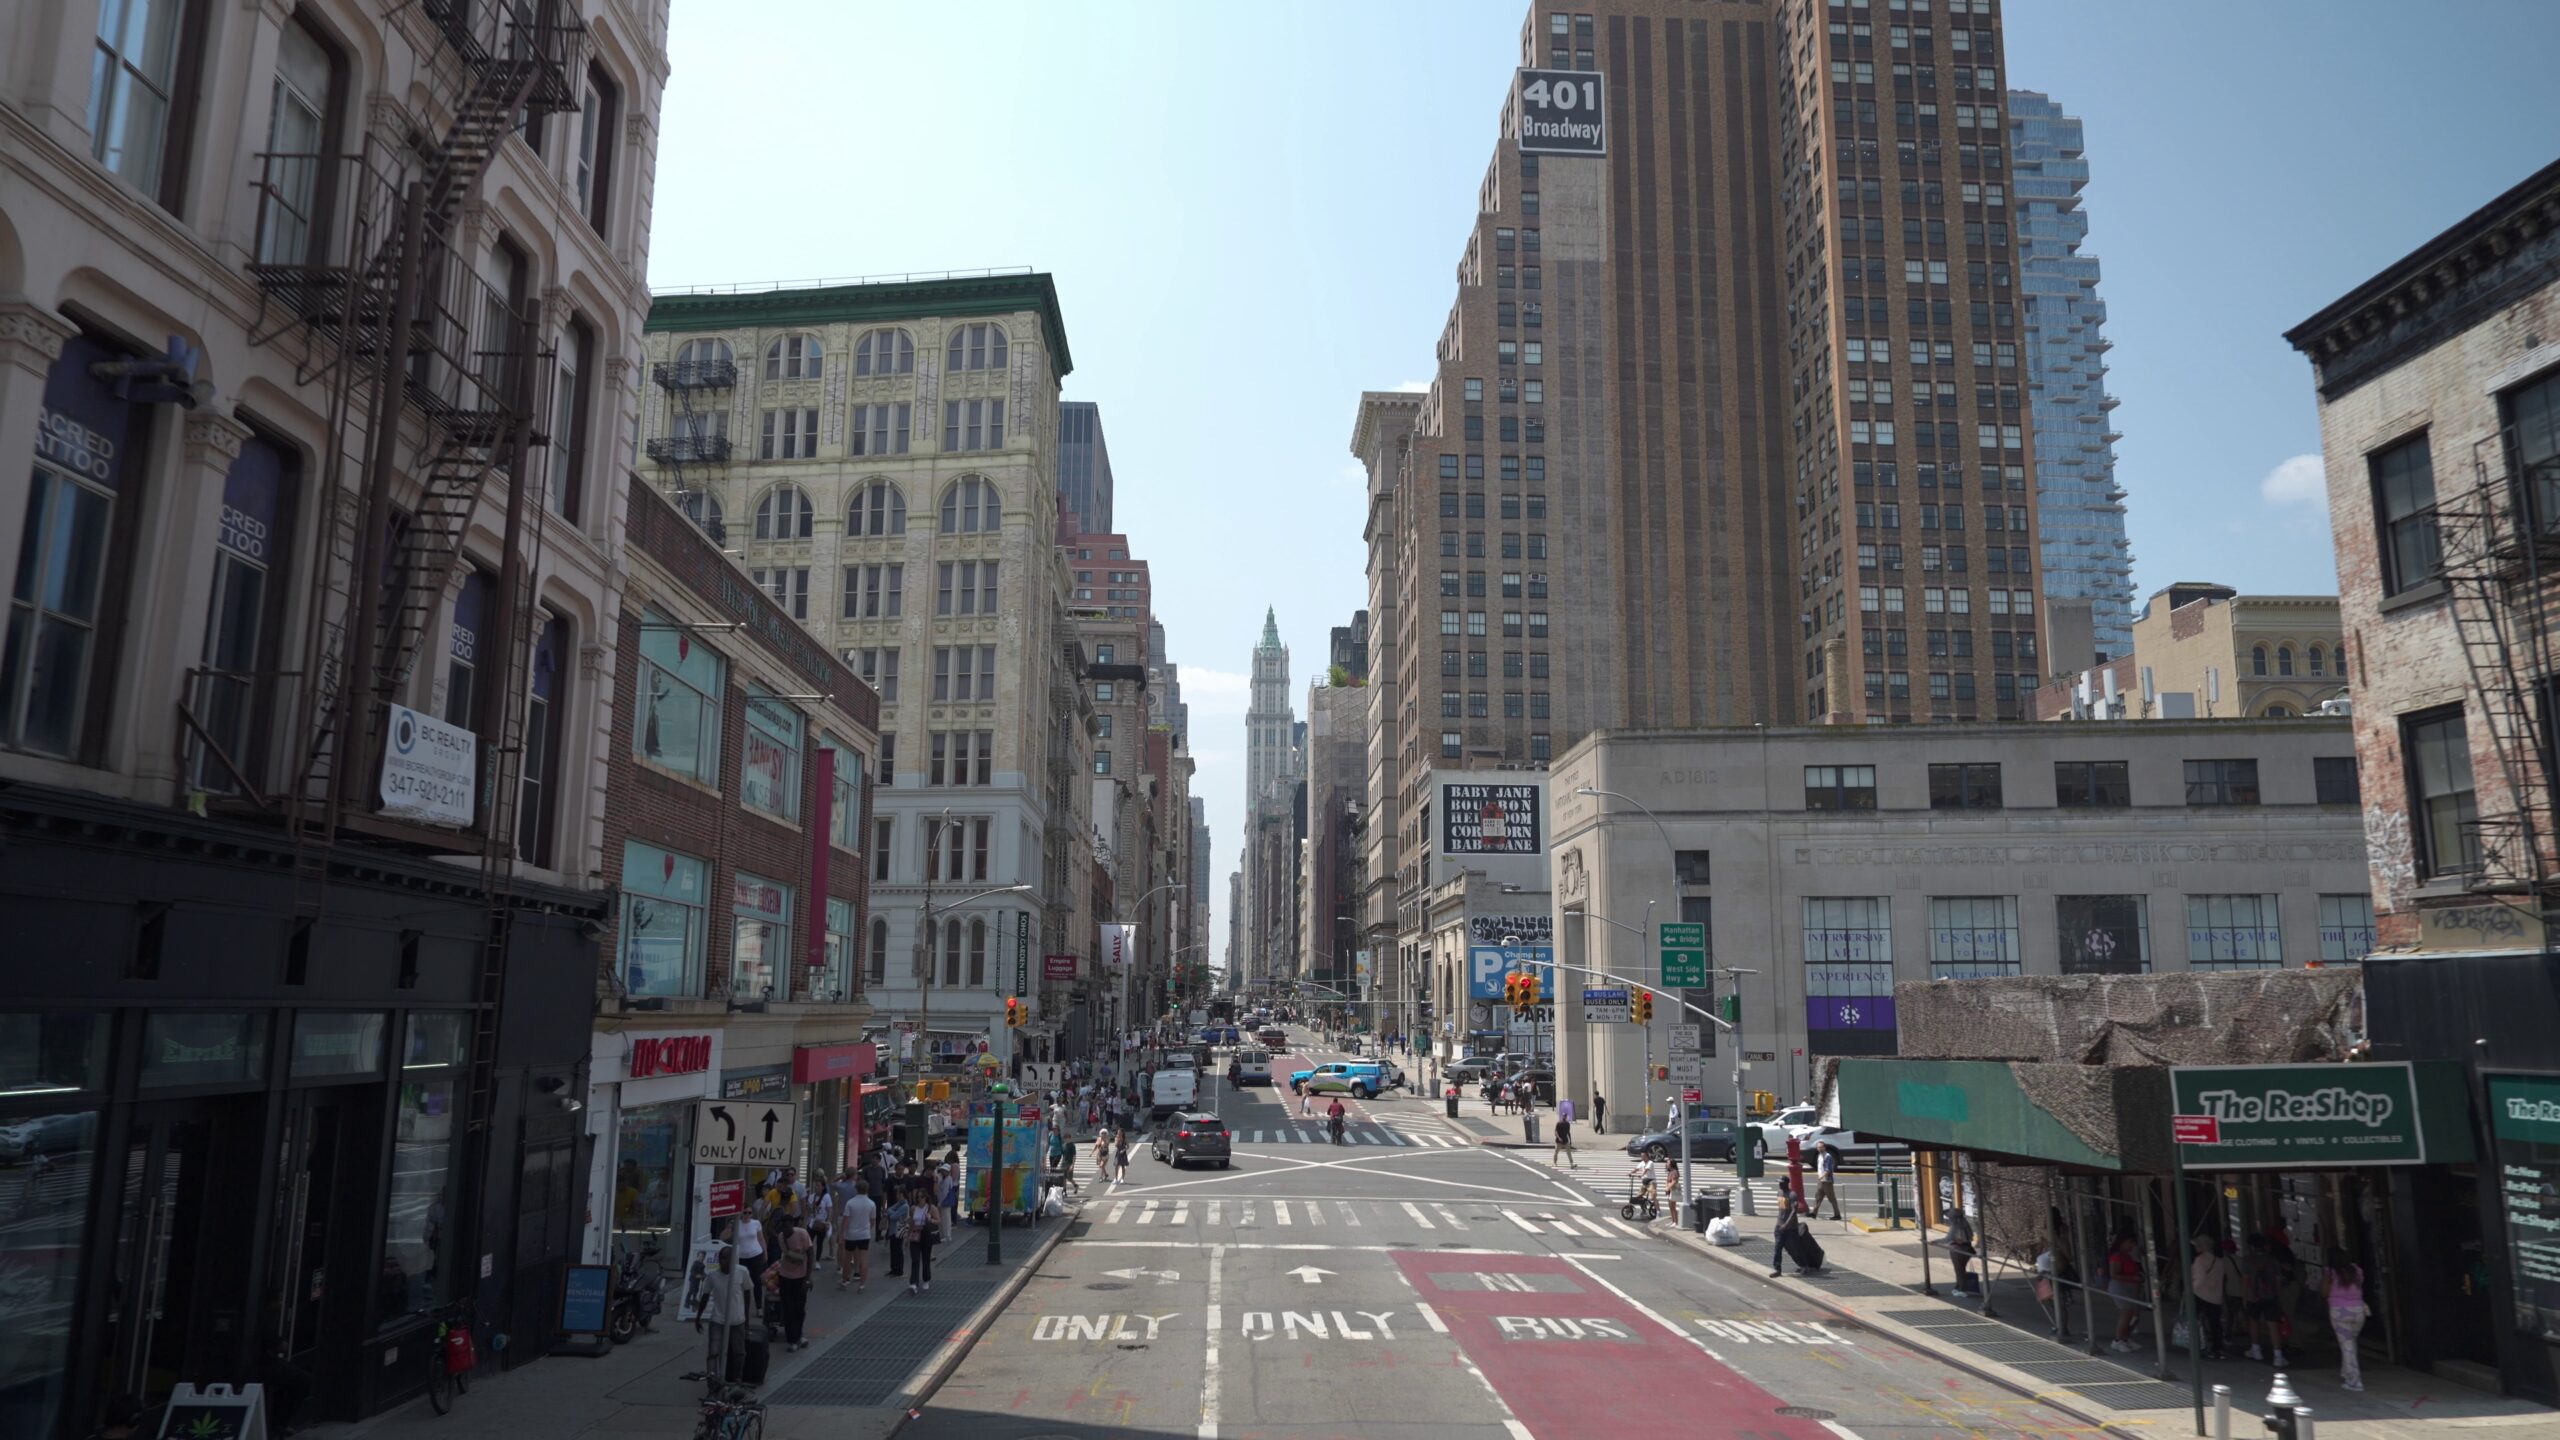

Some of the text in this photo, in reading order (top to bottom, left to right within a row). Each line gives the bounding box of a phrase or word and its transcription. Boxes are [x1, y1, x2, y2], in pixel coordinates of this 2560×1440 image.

[1523, 79, 1595, 110] 401
[1523, 115, 1601, 146] Broadway
[36, 405, 114, 459] ACRED
[34, 428, 110, 479] ATTOO
[219, 504, 266, 540] CRED
[451, 624, 475, 646] RED
[450, 639, 472, 660] TOO
[421, 725, 471, 754] BC REALTY
[389, 772, 465, 808] 347-921-2111
[1451, 786, 1532, 798] BABY JANE
[1451, 812, 1532, 824] HEIOOM
[1451, 825, 1532, 838] COR ORN
[1664, 926, 1700, 934] Manhattan
[1679, 935, 1700, 944] Bridge
[1940, 933, 2007, 943] ESCAPE
[2192, 931, 2279, 942] DISCOVER
[2352, 931, 2376, 942] JOU
[1018, 915, 1028, 993] SOHO GARDEN HOTEL
[1112, 935, 1121, 964] SALLY
[1504, 951, 1546, 959] Champon
[1834, 948, 1861, 957] ART
[1475, 951, 1552, 984] Par
[1810, 972, 1889, 982] EXPERIENCE
[1666, 975, 1681, 983] Hwy
[2199, 1087, 2393, 1127] The Re:Shop
[2506, 1098, 2560, 1123] The Re
[700, 1145, 738, 1158] ONLY
[2234, 1138, 2278, 1147] CLOTHING
[2294, 1137, 2326, 1146] VINYLS
[2342, 1135, 2404, 1145] COLLECTIBLES
[748, 1147, 786, 1160] ONLY
[1032, 1312, 1184, 1342] ONLY
[1241, 1310, 1398, 1341] ONLY
[1694, 1318, 1855, 1345] ONLY
